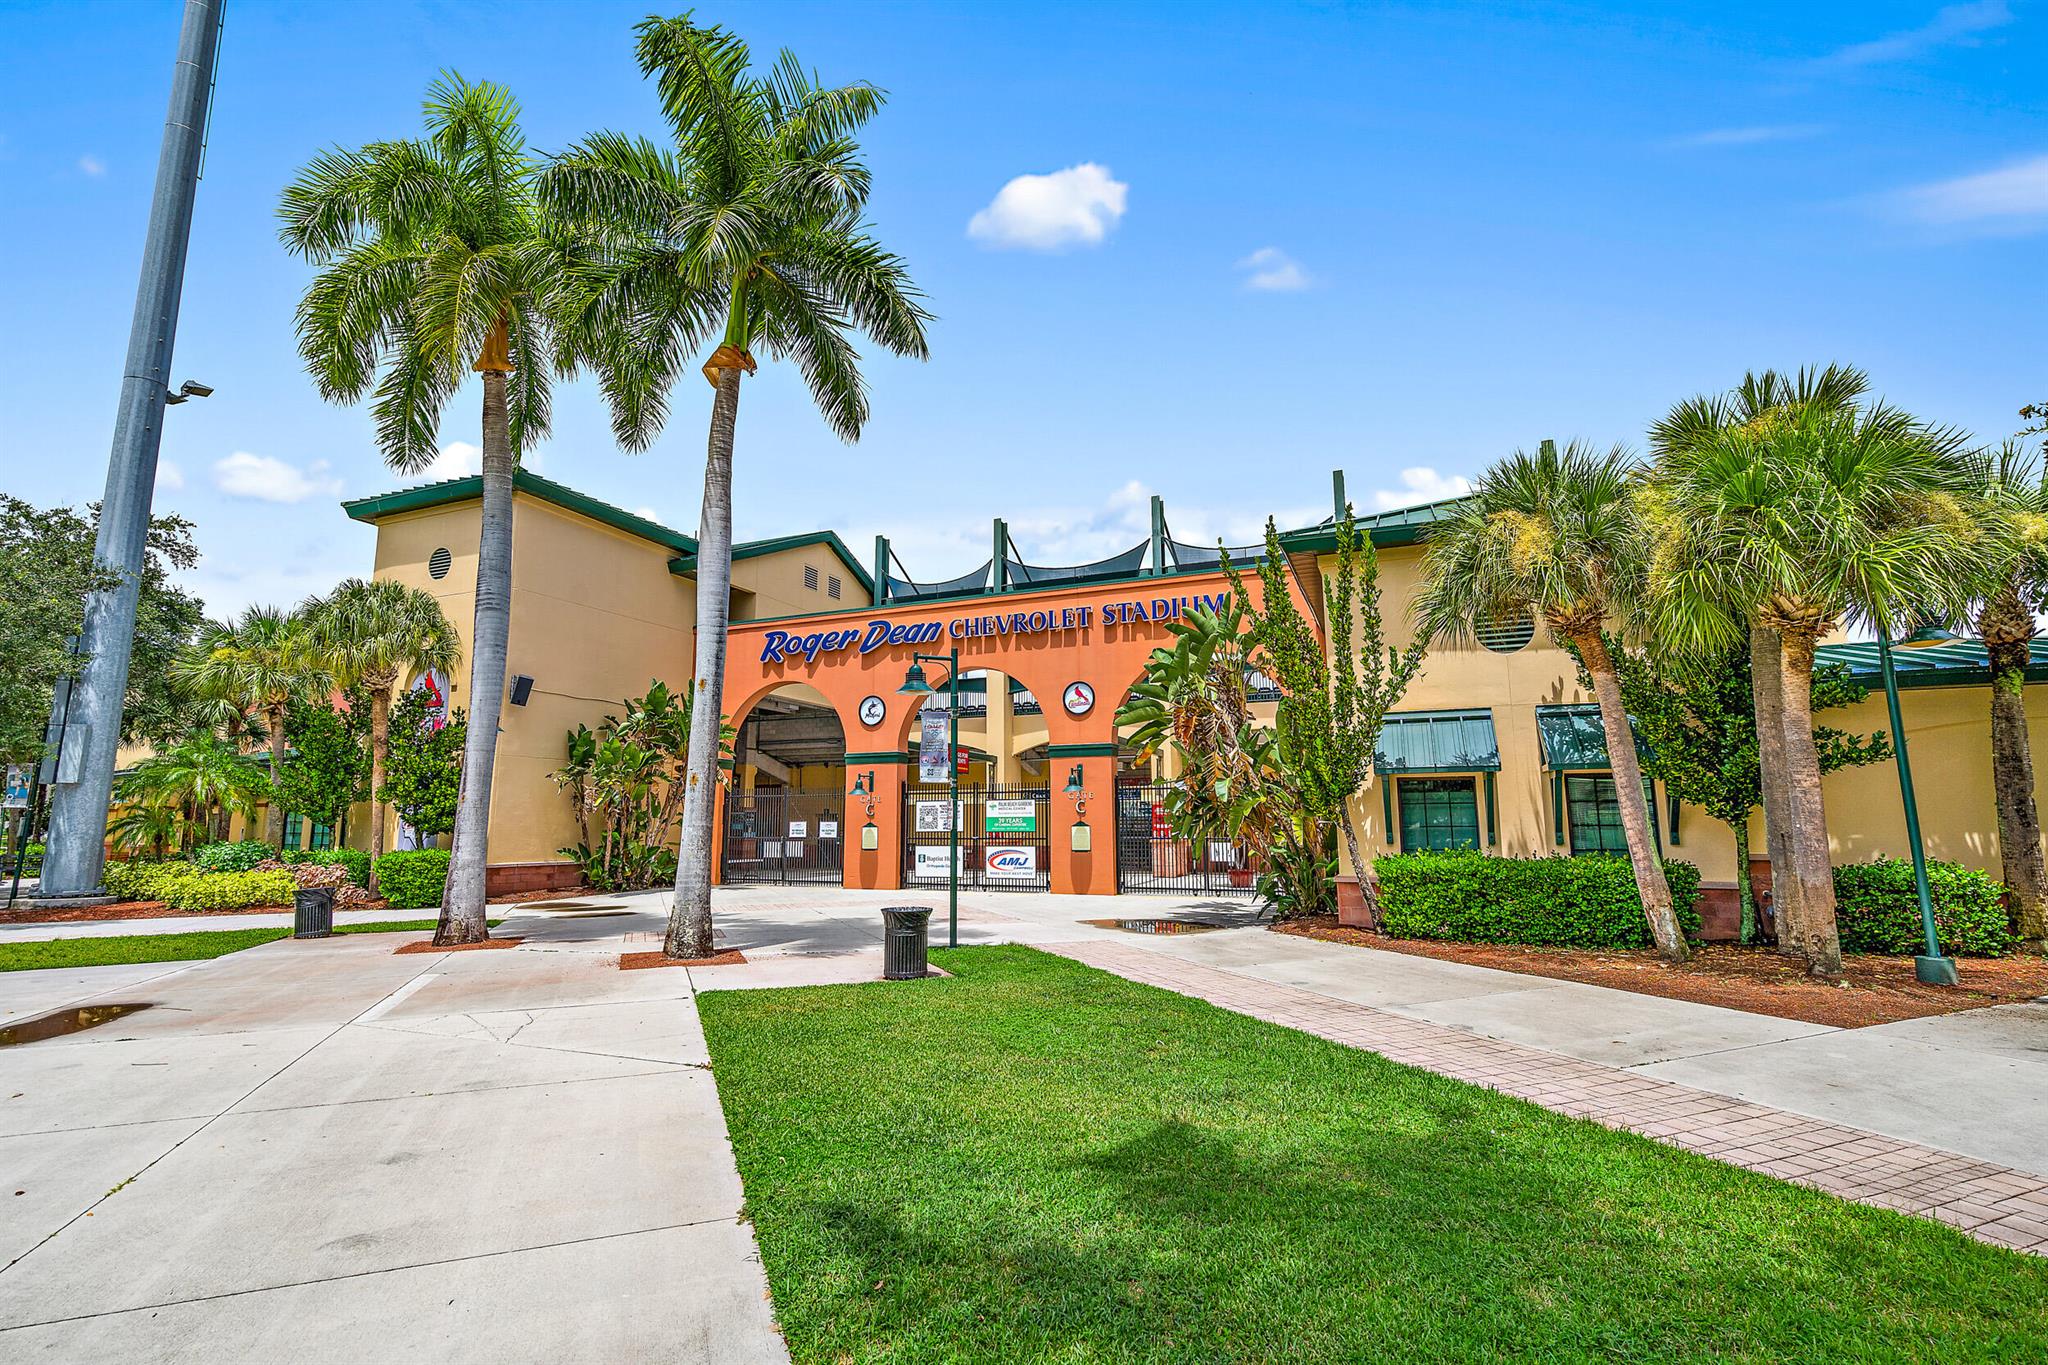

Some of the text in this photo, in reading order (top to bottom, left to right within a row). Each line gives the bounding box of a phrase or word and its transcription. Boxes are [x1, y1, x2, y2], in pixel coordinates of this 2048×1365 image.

[759, 628, 860, 664] Roger
[858, 619, 944, 654] Dean
[949, 606, 1093, 639] CHEVROLET
[860, 795, 881, 803] GATE
[1067, 791, 1094, 800] GATE
[866, 804, 875, 816] C
[1076, 800, 1086, 813] C
[997, 857, 1029, 866] AMJ
